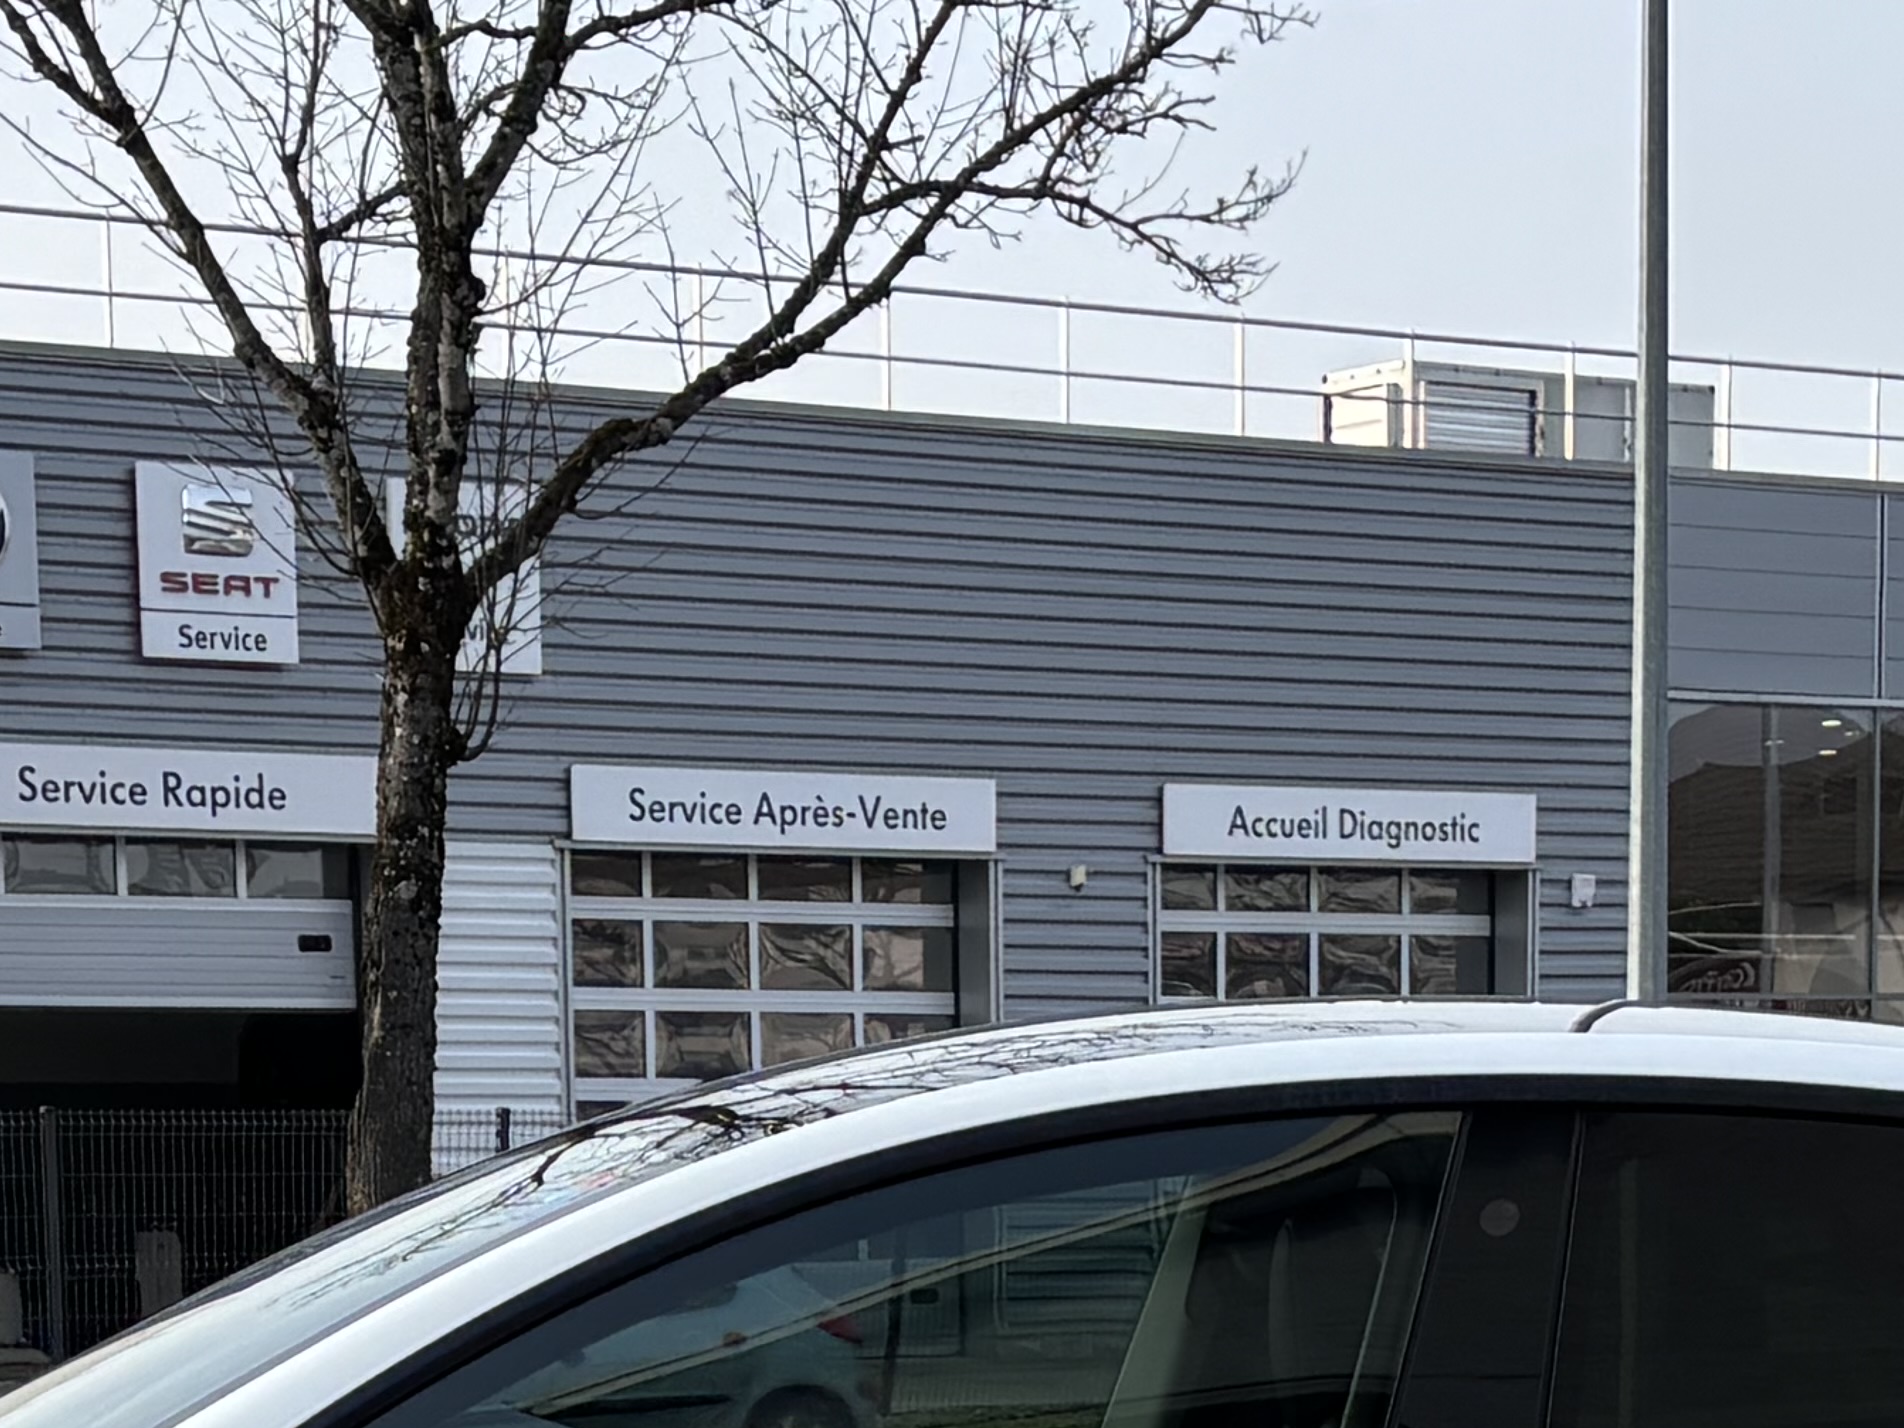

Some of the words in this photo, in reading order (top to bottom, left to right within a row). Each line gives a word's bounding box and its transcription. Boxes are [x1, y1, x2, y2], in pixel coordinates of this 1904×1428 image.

[159, 571, 281, 599] SEAT
[178, 624, 268, 653] Service
[17, 765, 148, 804] Service
[163, 771, 288, 818] Rapide
[627, 787, 743, 826] Service
[753, 789, 948, 836] Après-Vente
[1227, 804, 1328, 840] Accueil
[1339, 805, 1480, 846] Diagnostic
